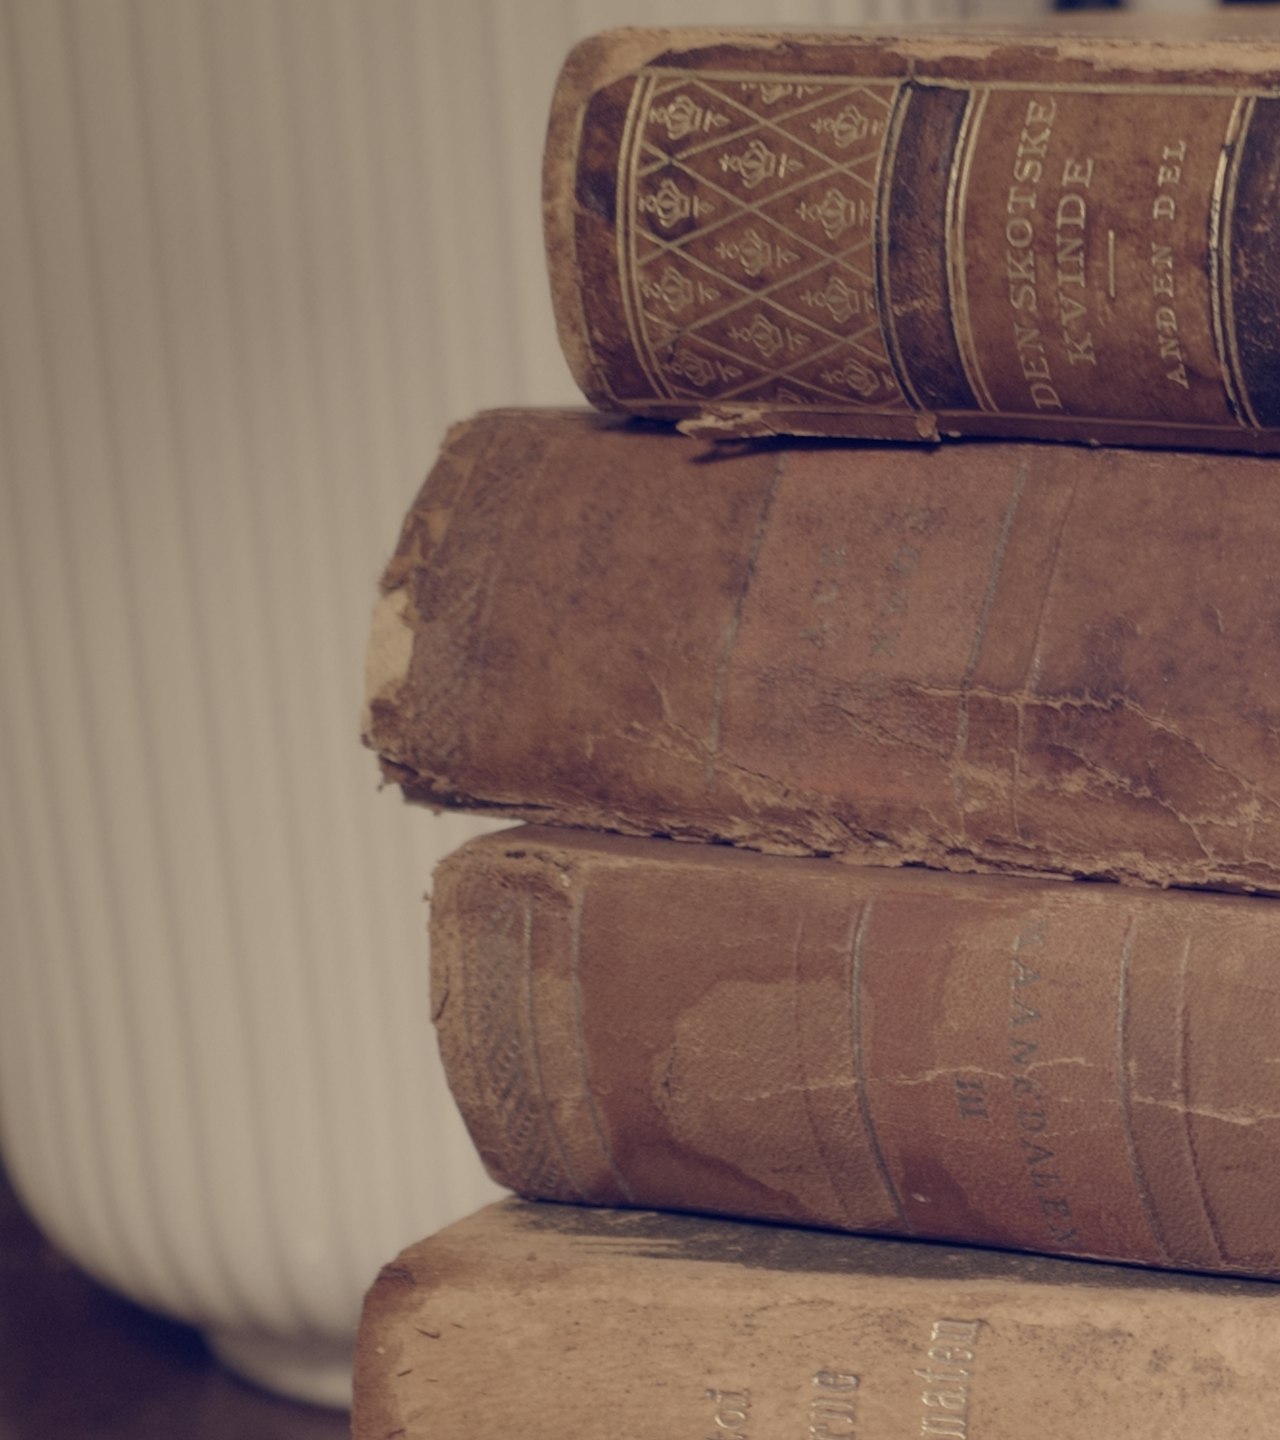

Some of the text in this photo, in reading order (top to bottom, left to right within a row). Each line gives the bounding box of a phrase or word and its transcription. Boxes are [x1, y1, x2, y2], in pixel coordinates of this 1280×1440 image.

[1005, 95, 1063, 408] DEN SKOTSKE
[1055, 157, 1097, 365] KVINDE
[1150, 139, 1190, 389] ANDEN DEL
